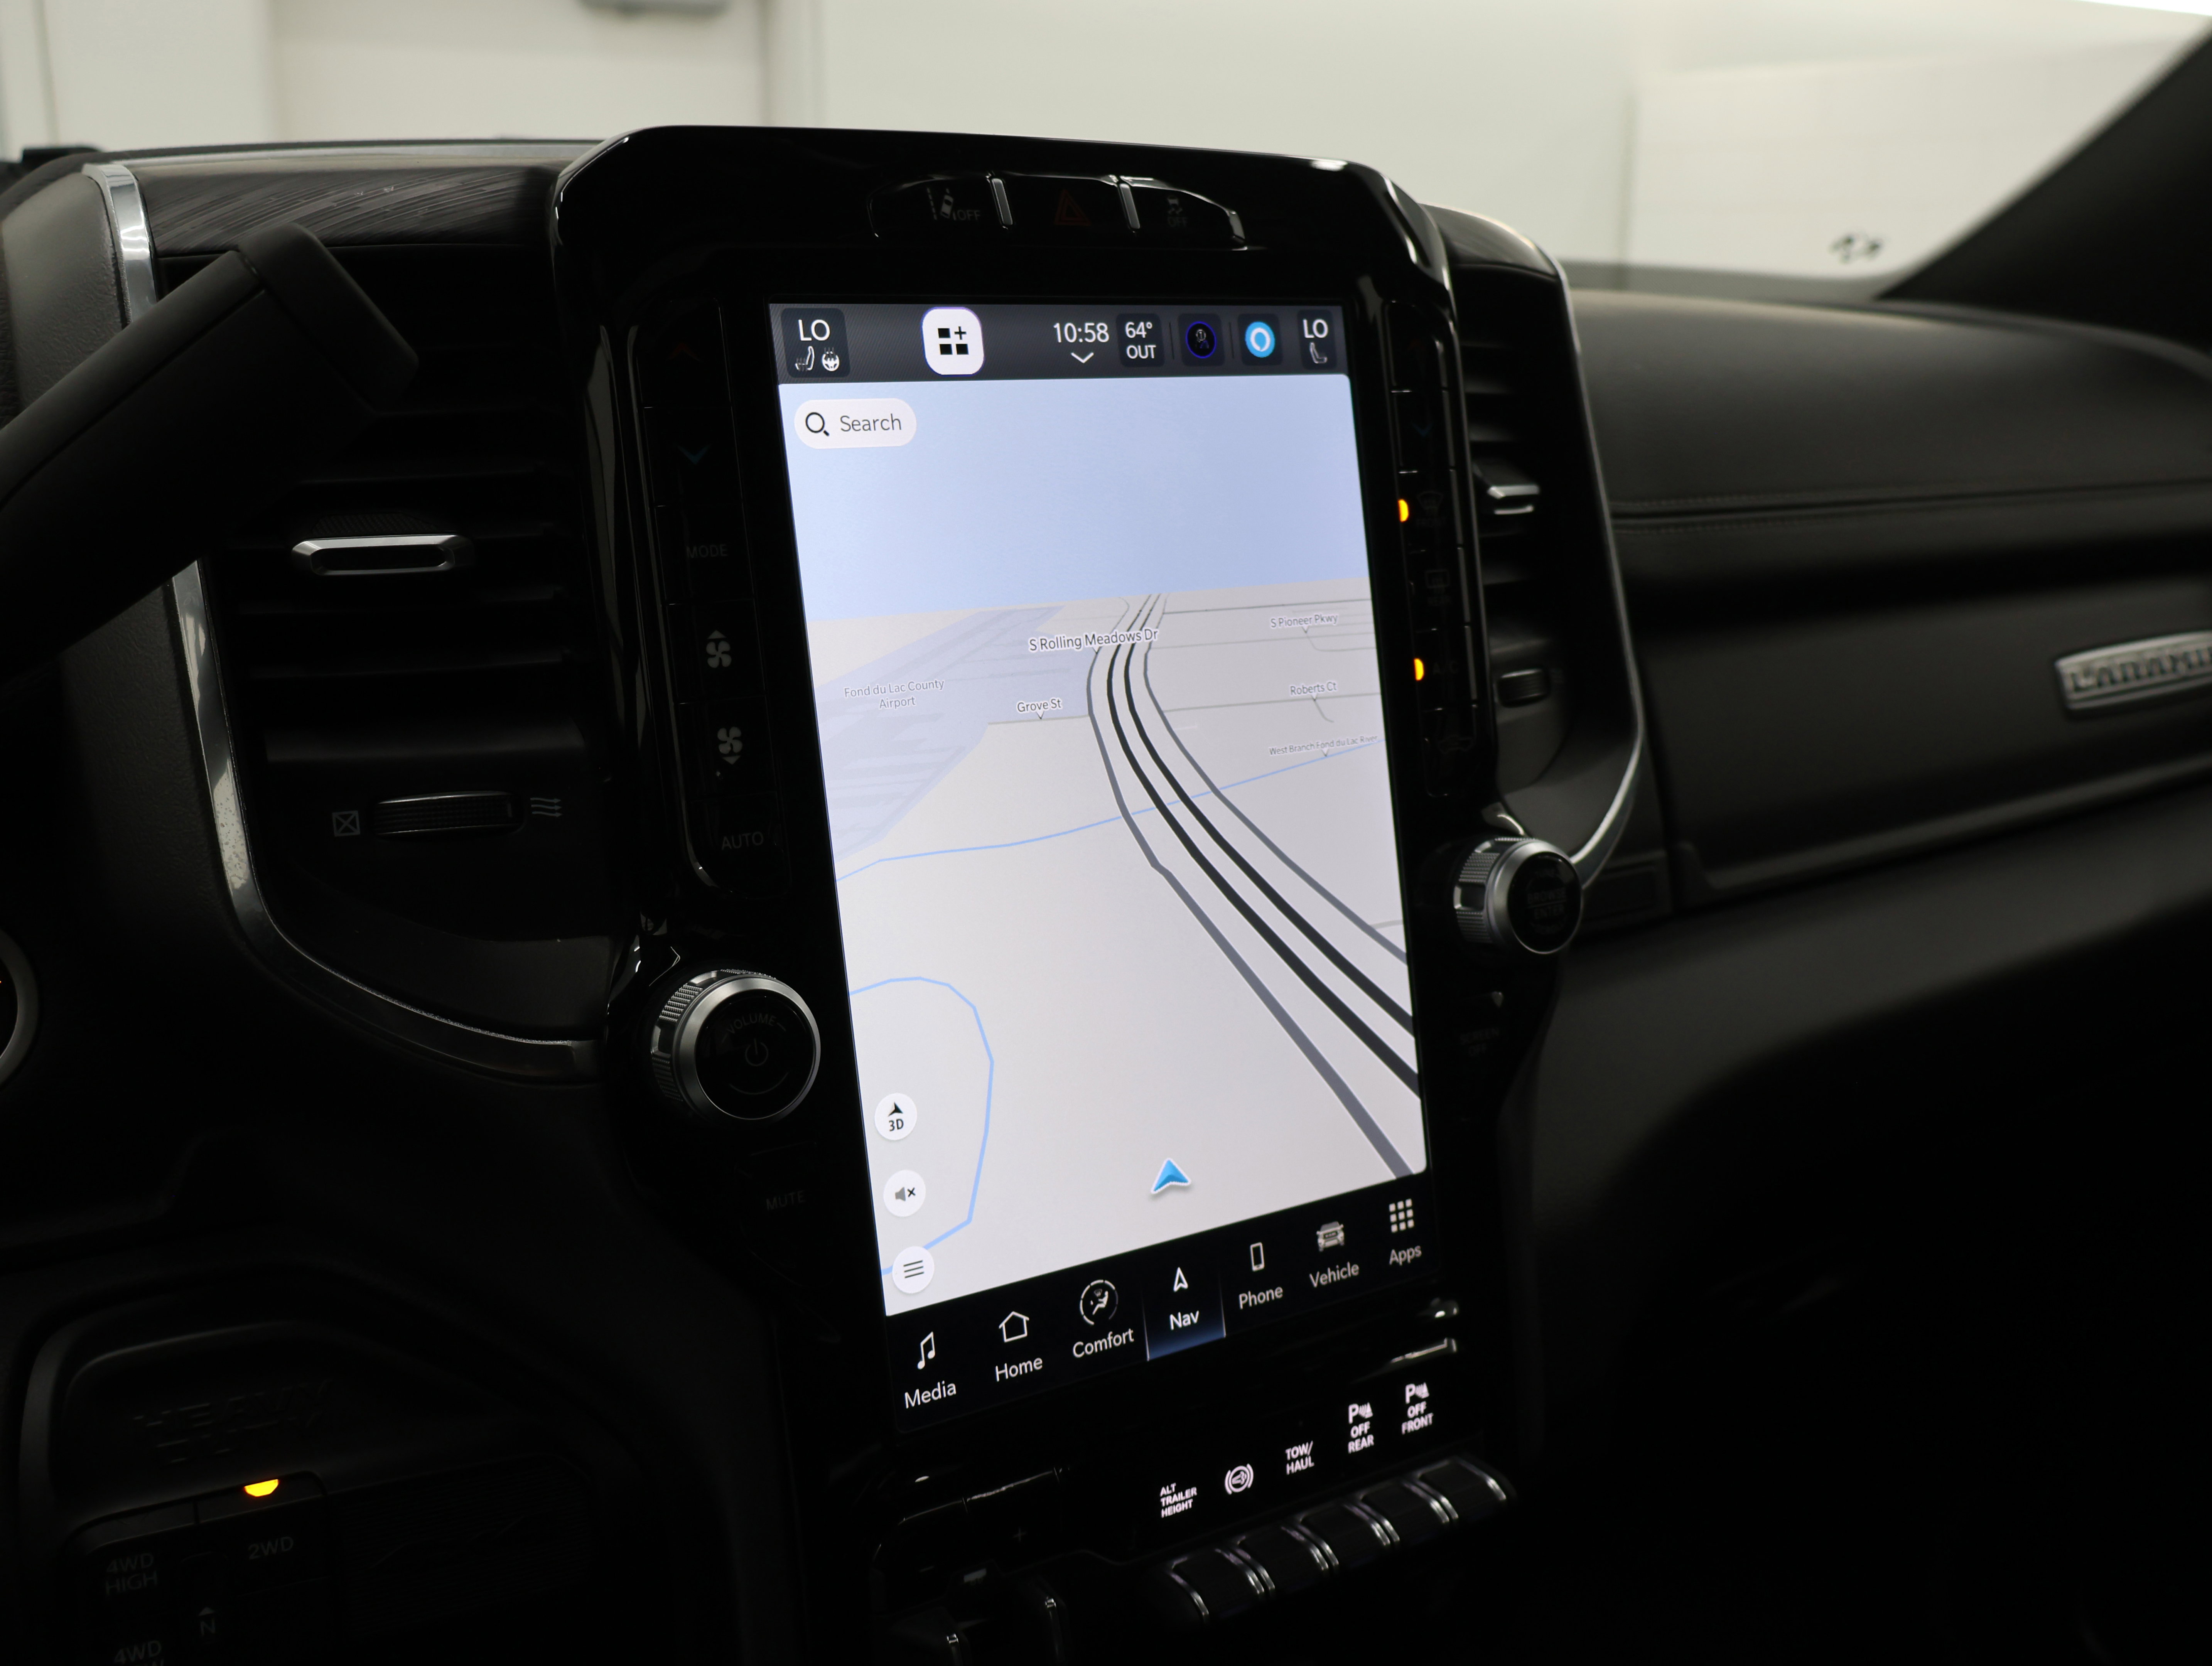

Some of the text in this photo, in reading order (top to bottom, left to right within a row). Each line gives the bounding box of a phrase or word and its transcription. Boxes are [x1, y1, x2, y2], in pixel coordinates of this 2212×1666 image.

[957, 210, 981, 221] OFF
[1167, 216, 1188, 228] OFF
[798, 319, 830, 341] LO
[1054, 322, 1110, 344] 10:58
[1125, 321, 1153, 338] 64°
[1303, 319, 1328, 339] LO
[1126, 344, 1156, 359] OUT
[840, 413, 902, 432] Search
[685, 544, 729, 559] MODE
[1271, 614, 1338, 628] S Pioneer Pkwy
[1029, 629, 1158, 651] S Rolling Meadows Dr
[2070, 646, 2212, 693] LARAMI
[844, 680, 944, 697] Fond du Lac County
[1290, 681, 1336, 695] Roberts Ct
[879, 696, 916, 710] Airport
[1017, 698, 1061, 713] Grove St
[1269, 735, 1378, 756] West Branch Fond du Lac River
[721, 831, 764, 850] AUTO
[1527, 887, 1567, 904] BROWSE
[1534, 904, 1565, 920] ENTER
[726, 1012, 777, 1034] VOLUME
[1459, 1027, 1500, 1046] SCREEN
[1468, 1042, 1487, 1057] OFF
[888, 1119, 904, 1132] 3D
[766, 1189, 806, 1212] MUTE
[1389, 1245, 1422, 1265] Apps
[1309, 1261, 1360, 1288] Vehicle
[1238, 1286, 1283, 1309] Phone
[1169, 1310, 1200, 1330] Nav
[1072, 1328, 1134, 1358] Comfort
[995, 1357, 1043, 1382] Home
[904, 1381, 957, 1409] Media
[1407, 1401, 1427, 1418] OFF
[1350, 1421, 1370, 1439] OFF
[1401, 1413, 1434, 1435] FRONT
[1285, 1440, 1313, 1460] TOW/
[1348, 1434, 1374, 1454] REAR
[1286, 1456, 1314, 1475] HAUL
[1159, 1483, 1176, 1497] ALT
[1160, 1486, 1197, 1507] TRAILER
[1161, 1499, 1194, 1518] HEIGHT
[248, 1536, 295, 1560] 2WD
[106, 1553, 154, 1574] 4WD
[105, 1570, 159, 1597] HIGH
[199, 1619, 217, 1637] N
[113, 1640, 162, 1664] 4WD
